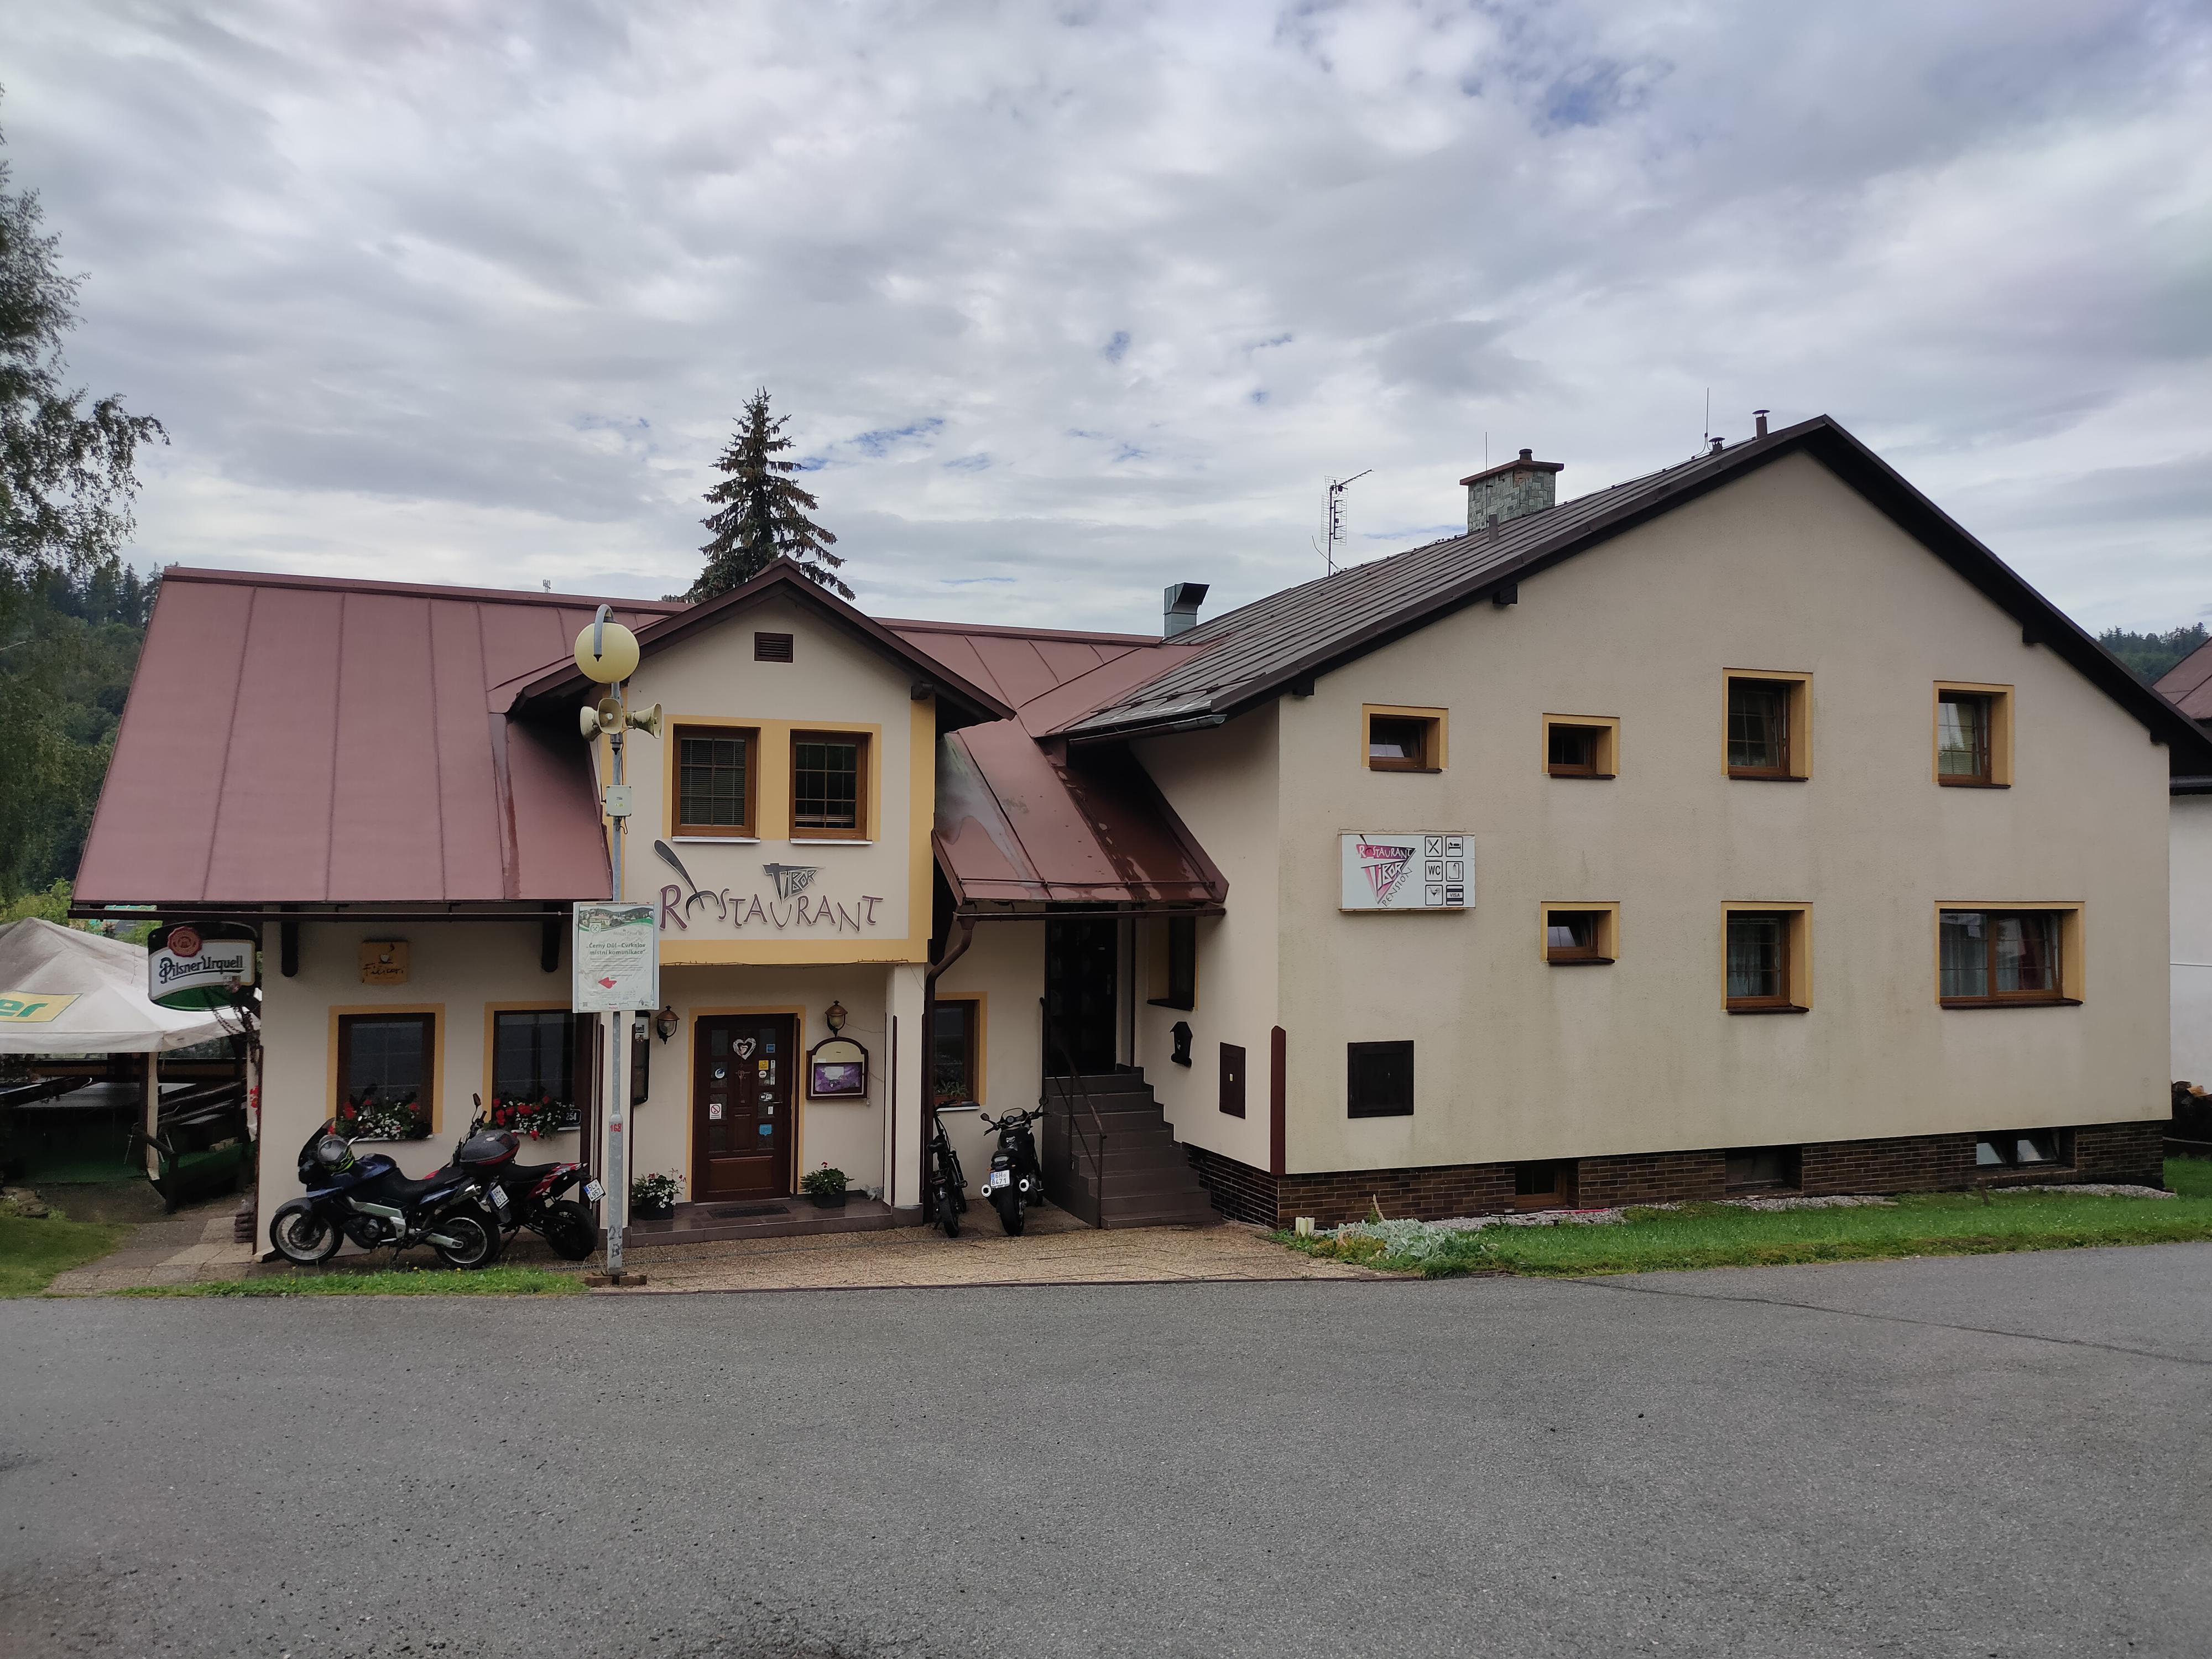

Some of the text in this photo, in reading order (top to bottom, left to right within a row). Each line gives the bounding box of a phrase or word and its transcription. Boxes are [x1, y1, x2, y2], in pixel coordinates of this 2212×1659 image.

[1428, 865, 1441, 875] WC
[1382, 867, 1412, 907] PENSION
[159, 954, 243, 984] Pilsner Urquell
